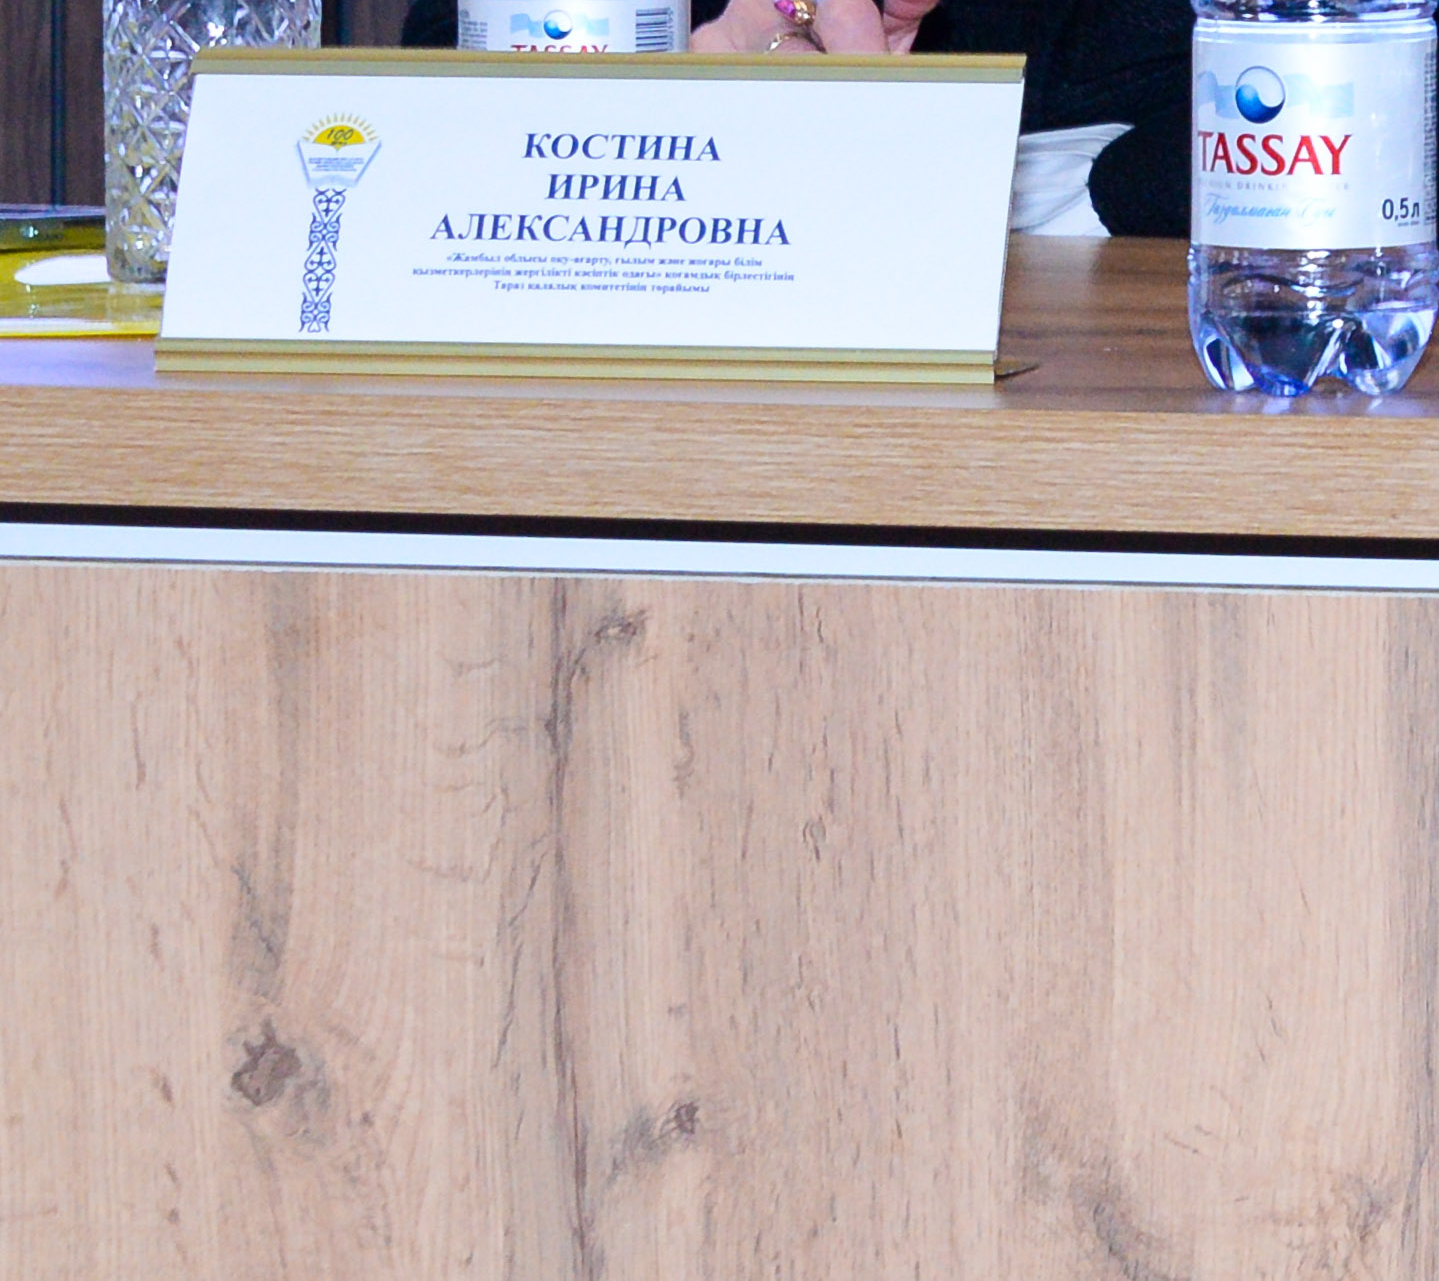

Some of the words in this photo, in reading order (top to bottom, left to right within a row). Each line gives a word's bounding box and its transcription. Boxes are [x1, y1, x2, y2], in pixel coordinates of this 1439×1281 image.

[521, 132, 721, 162] КОСТИНА
[1196, 129, 1355, 178] TASSAY
[544, 173, 687, 202] ИРИНА
[1382, 197, 1420, 222] 0,5л
[429, 212, 792, 250] АЛЕКСАНДРОВНА
